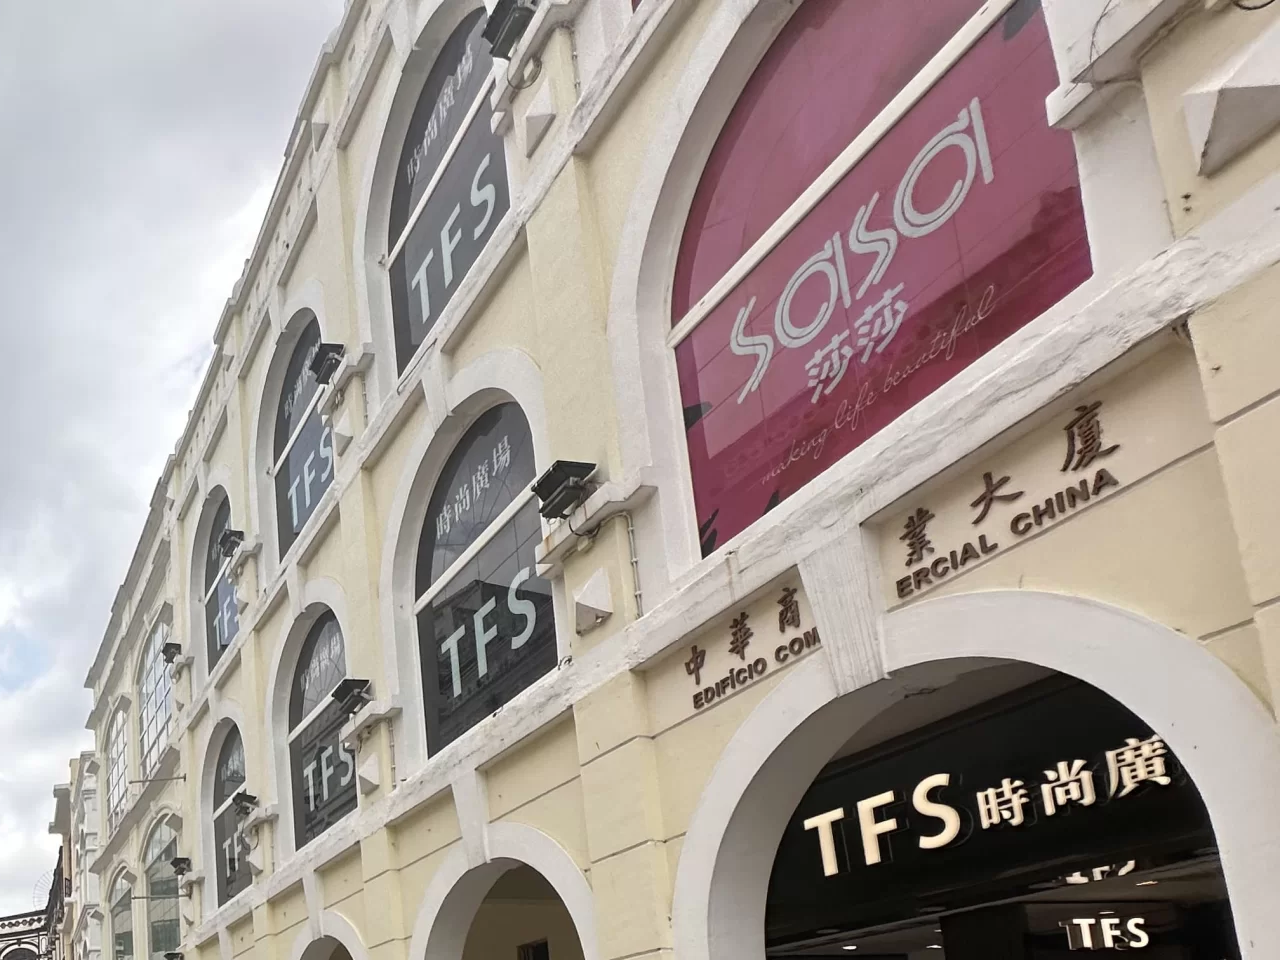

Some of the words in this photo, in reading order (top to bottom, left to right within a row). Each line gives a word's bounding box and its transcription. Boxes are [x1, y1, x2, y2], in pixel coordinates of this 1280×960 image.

[411, 152, 497, 325] TFS
[730, 97, 994, 405] sasa
[760, 427, 833, 485] making
[834, 382, 878, 431] life
[883, 284, 995, 393] beautiful
[804, 282, 910, 404] 莎莎
[287, 426, 333, 528] TFS
[436, 434, 513, 541] 時尚廣場
[440, 566, 537, 699] TFS
[692, 657, 768, 710] EDIFÍCIO
[895, 533, 999, 599] ERCIAL
[1010, 467, 1120, 536] CHINA
[303, 731, 354, 812] TFS
[803, 772, 962, 877] TFS
[975, 734, 1172, 831] 時尚廣
[1070, 917, 1150, 949] TFS
